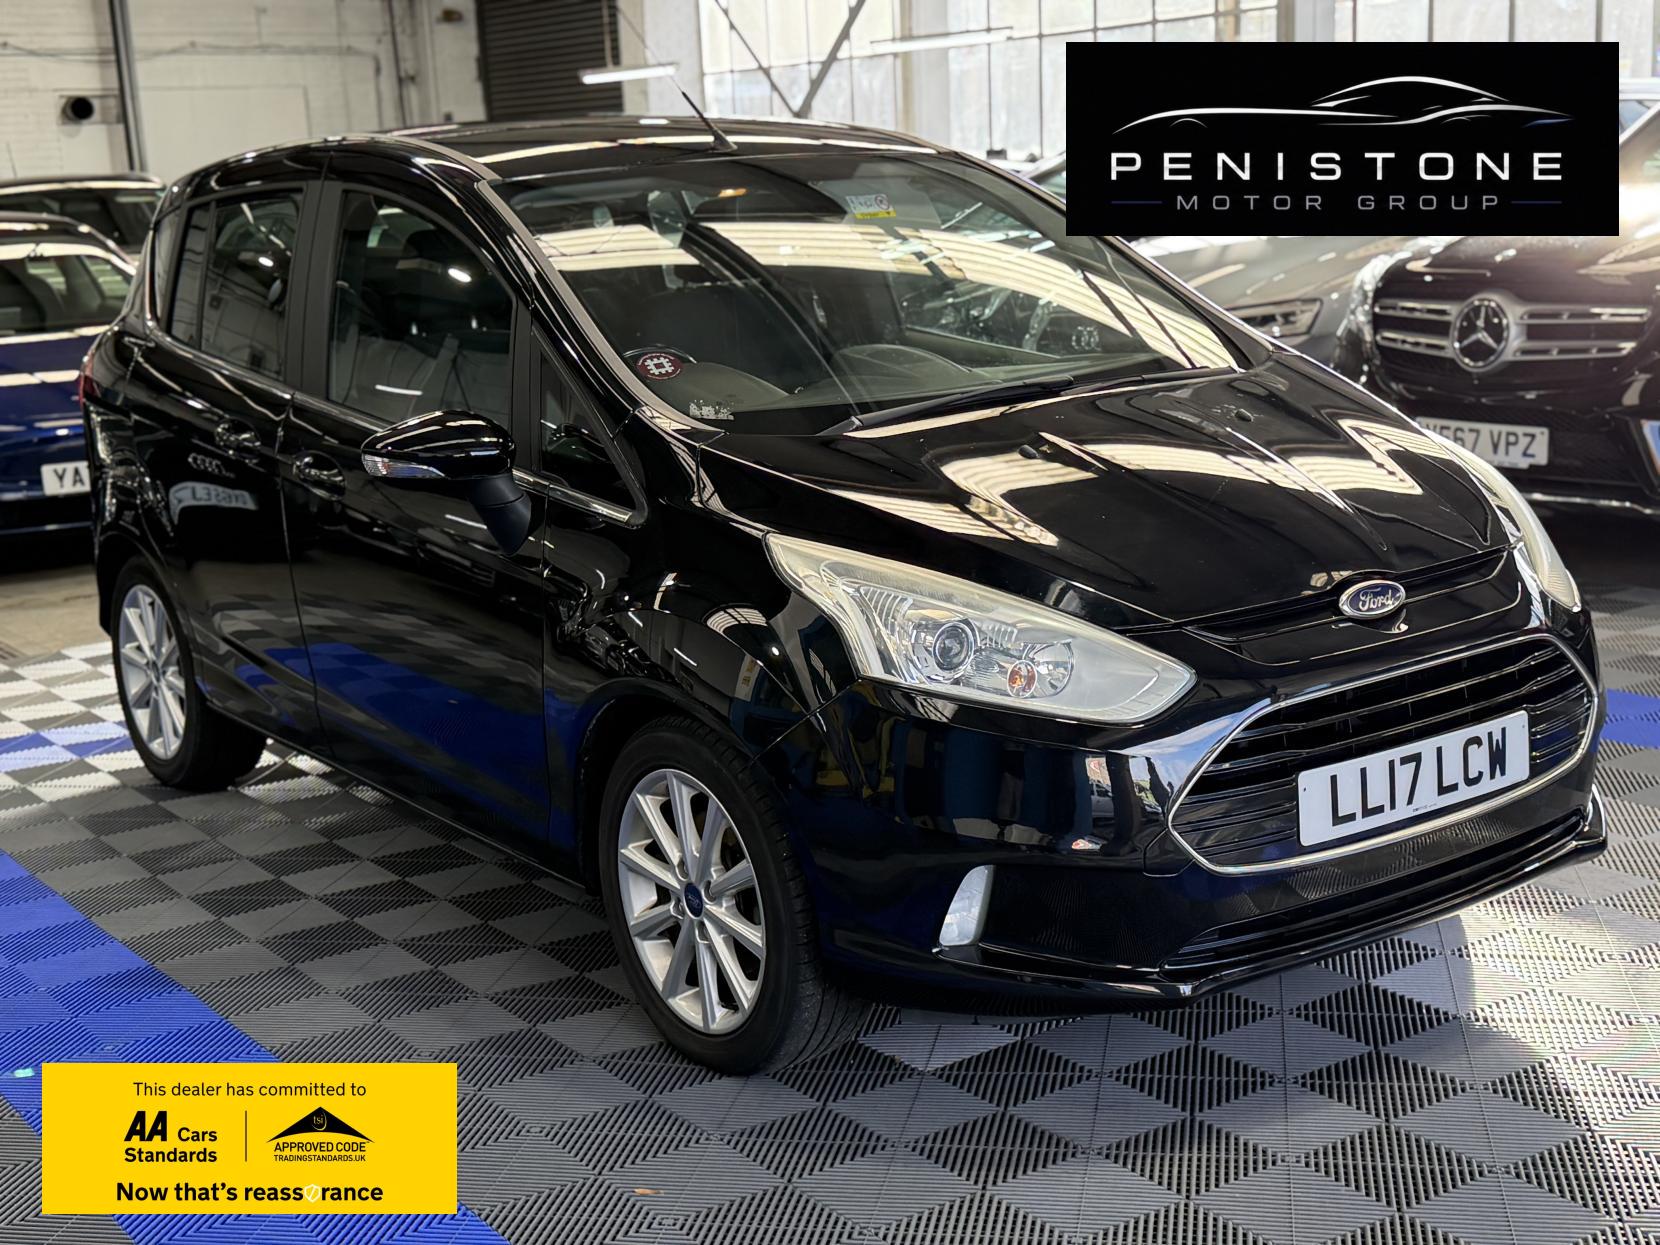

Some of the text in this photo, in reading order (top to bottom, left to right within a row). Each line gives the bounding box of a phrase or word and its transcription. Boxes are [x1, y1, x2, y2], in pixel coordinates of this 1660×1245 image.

[1426, 423, 1537, 459] 67 VPZ
[53, 466, 86, 488] YA
[1359, 586, 1394, 612] Ford
[1329, 726, 1507, 827] LL17 LCW
